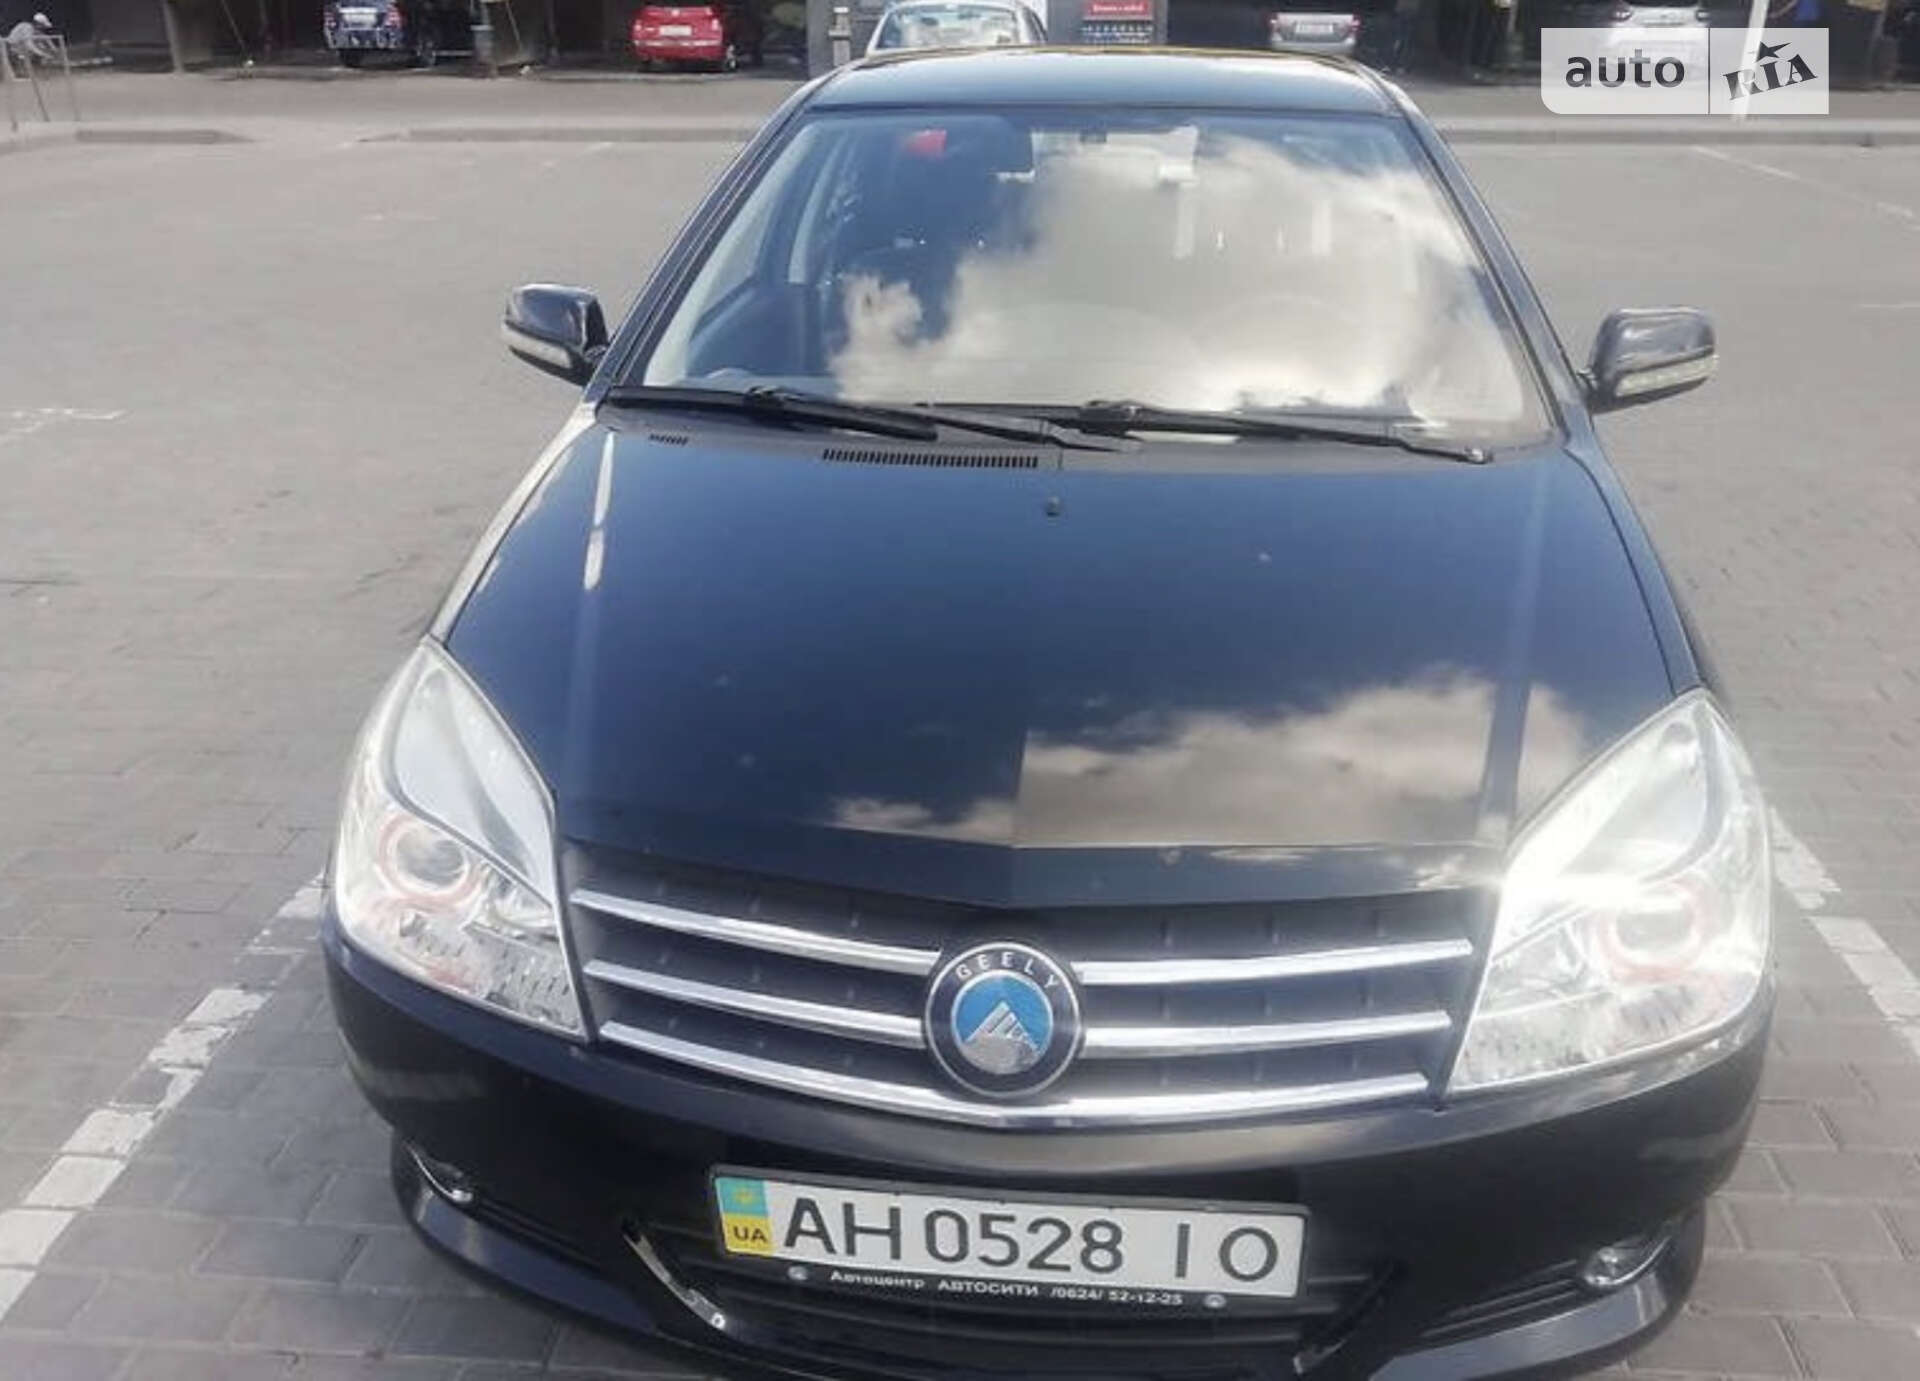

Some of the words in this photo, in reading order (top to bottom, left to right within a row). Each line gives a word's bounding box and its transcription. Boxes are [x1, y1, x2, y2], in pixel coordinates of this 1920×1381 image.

[956, 951, 1060, 988] GEELY
[733, 1226, 767, 1243] UA
[783, 1197, 900, 1260] AH
[924, 1209, 1124, 1274] 0528
[938, 1279, 1039, 1297] АВТОСИТИ
